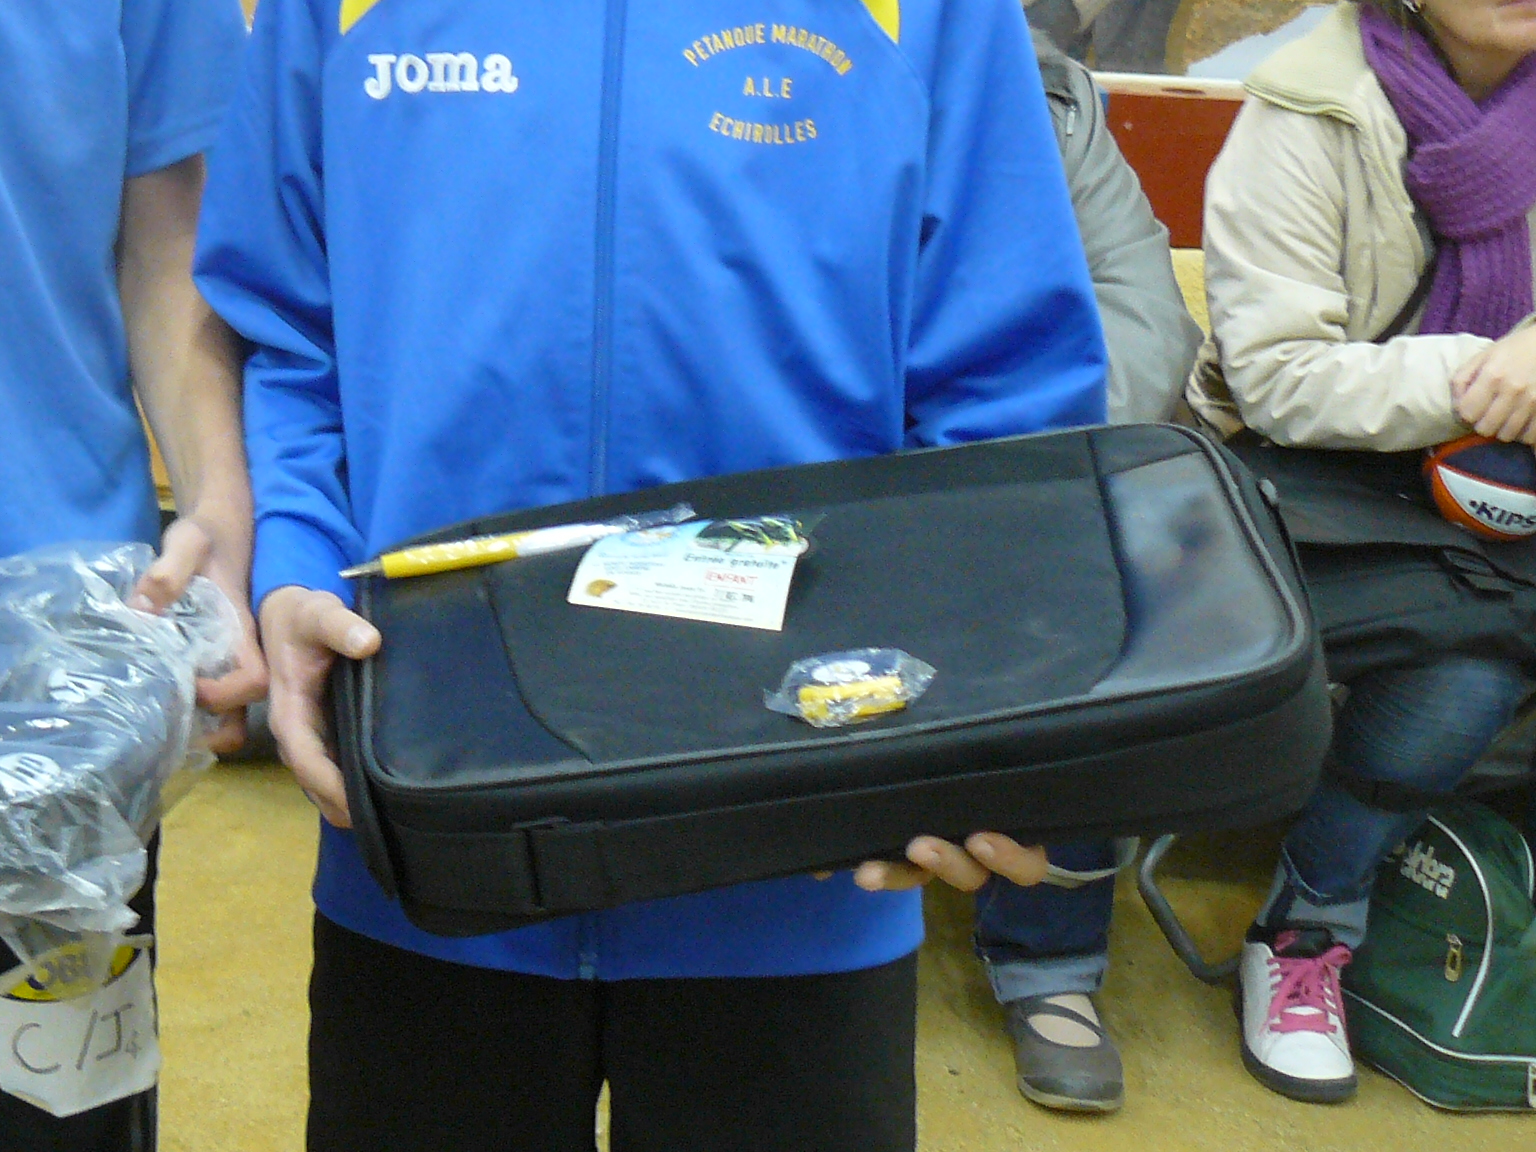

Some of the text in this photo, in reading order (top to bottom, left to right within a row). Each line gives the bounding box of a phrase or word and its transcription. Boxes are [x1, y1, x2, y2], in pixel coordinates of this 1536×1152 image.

[682, 22, 853, 76] PETANQUE MARATHON
[709, 111, 817, 145] ECHIROLLES
